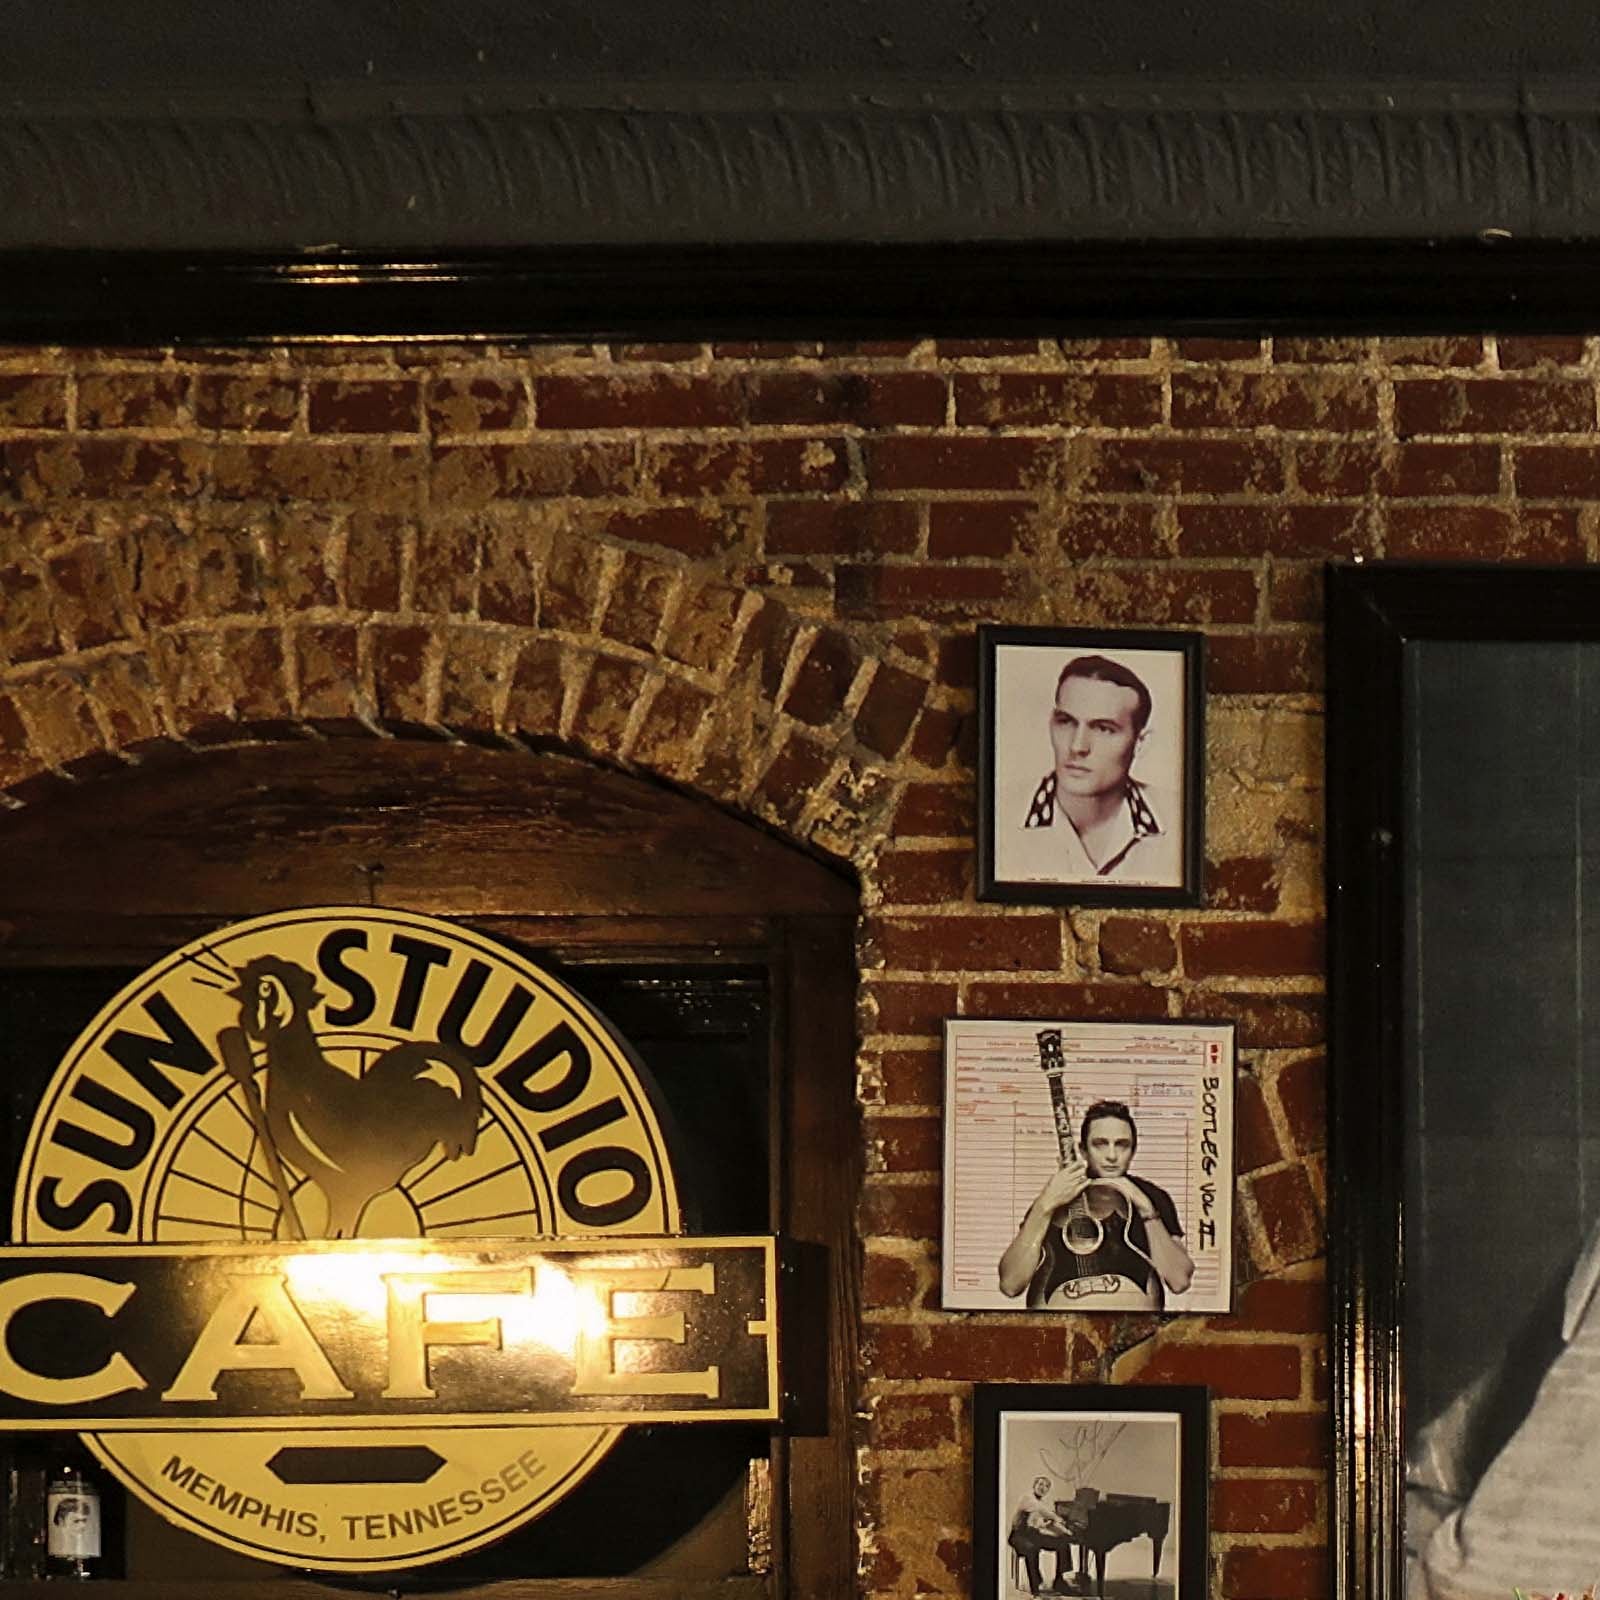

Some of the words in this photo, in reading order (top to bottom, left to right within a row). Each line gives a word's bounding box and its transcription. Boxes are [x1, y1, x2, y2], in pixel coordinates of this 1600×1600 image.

[38, 991, 219, 1235] SUN
[317, 928, 651, 1228] STUDIO
[1201, 1077, 1219, 1176] BOOTLEG
[0, 1262, 720, 1404] CAFE
[161, 1454, 330, 1543] MEMPHIS,
[342, 1449, 548, 1541] TENNESSEE
